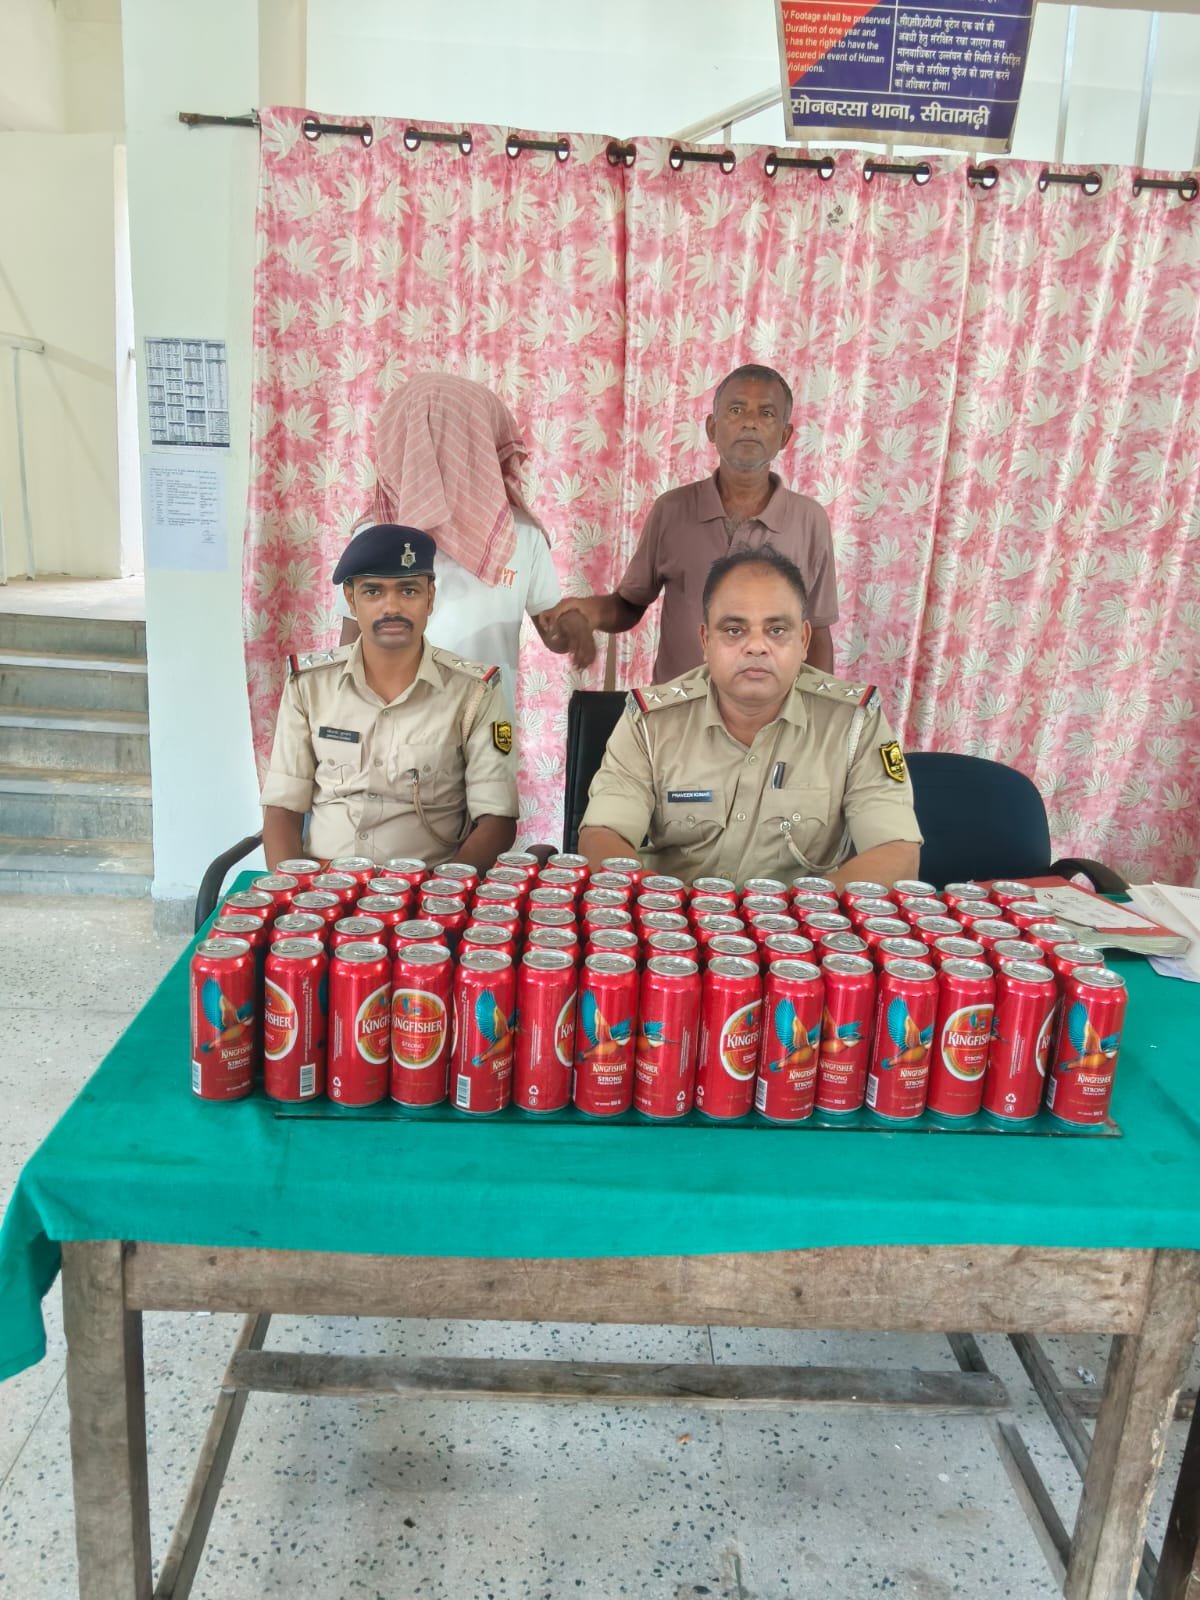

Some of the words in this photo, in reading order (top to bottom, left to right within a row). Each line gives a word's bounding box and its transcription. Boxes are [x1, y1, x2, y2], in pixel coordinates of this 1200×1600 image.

[790, 10, 821, 21] Footage
[823, 12, 840, 22] shall
[842, 13, 852, 23] be
[853, 15, 891, 25] preserved
[785, 24, 818, 33] Duration
[820, 25, 828, 34] of
[829, 27, 842, 35] one
[844, 28, 860, 37] year
[862, 28, 876, 37] and
[961, 19, 973, 32] एक
[790, 38, 803, 46] has
[806, 38, 817, 46] the
[820, 39, 836, 49] right
[838, 40, 846, 48] to
[847, 40, 865, 49] have
[867, 41, 879, 50] the
[786, 51, 816, 59] secured
[819, 52, 825, 60] in
[826, 53, 847, 61] event
[849, 53, 857, 62] of
[858, 54, 885, 64] Human
[791, 94, 869, 118] सोनबरसा
[871, 103, 915, 122] थाना,
[920, 101, 991, 130] सीतामढ़ी
[592, 1063, 627, 1073] KINGFISHER
[823, 1072, 848, 1081] STRONG
[1077, 1072, 1112, 1084] KINGFISHER
